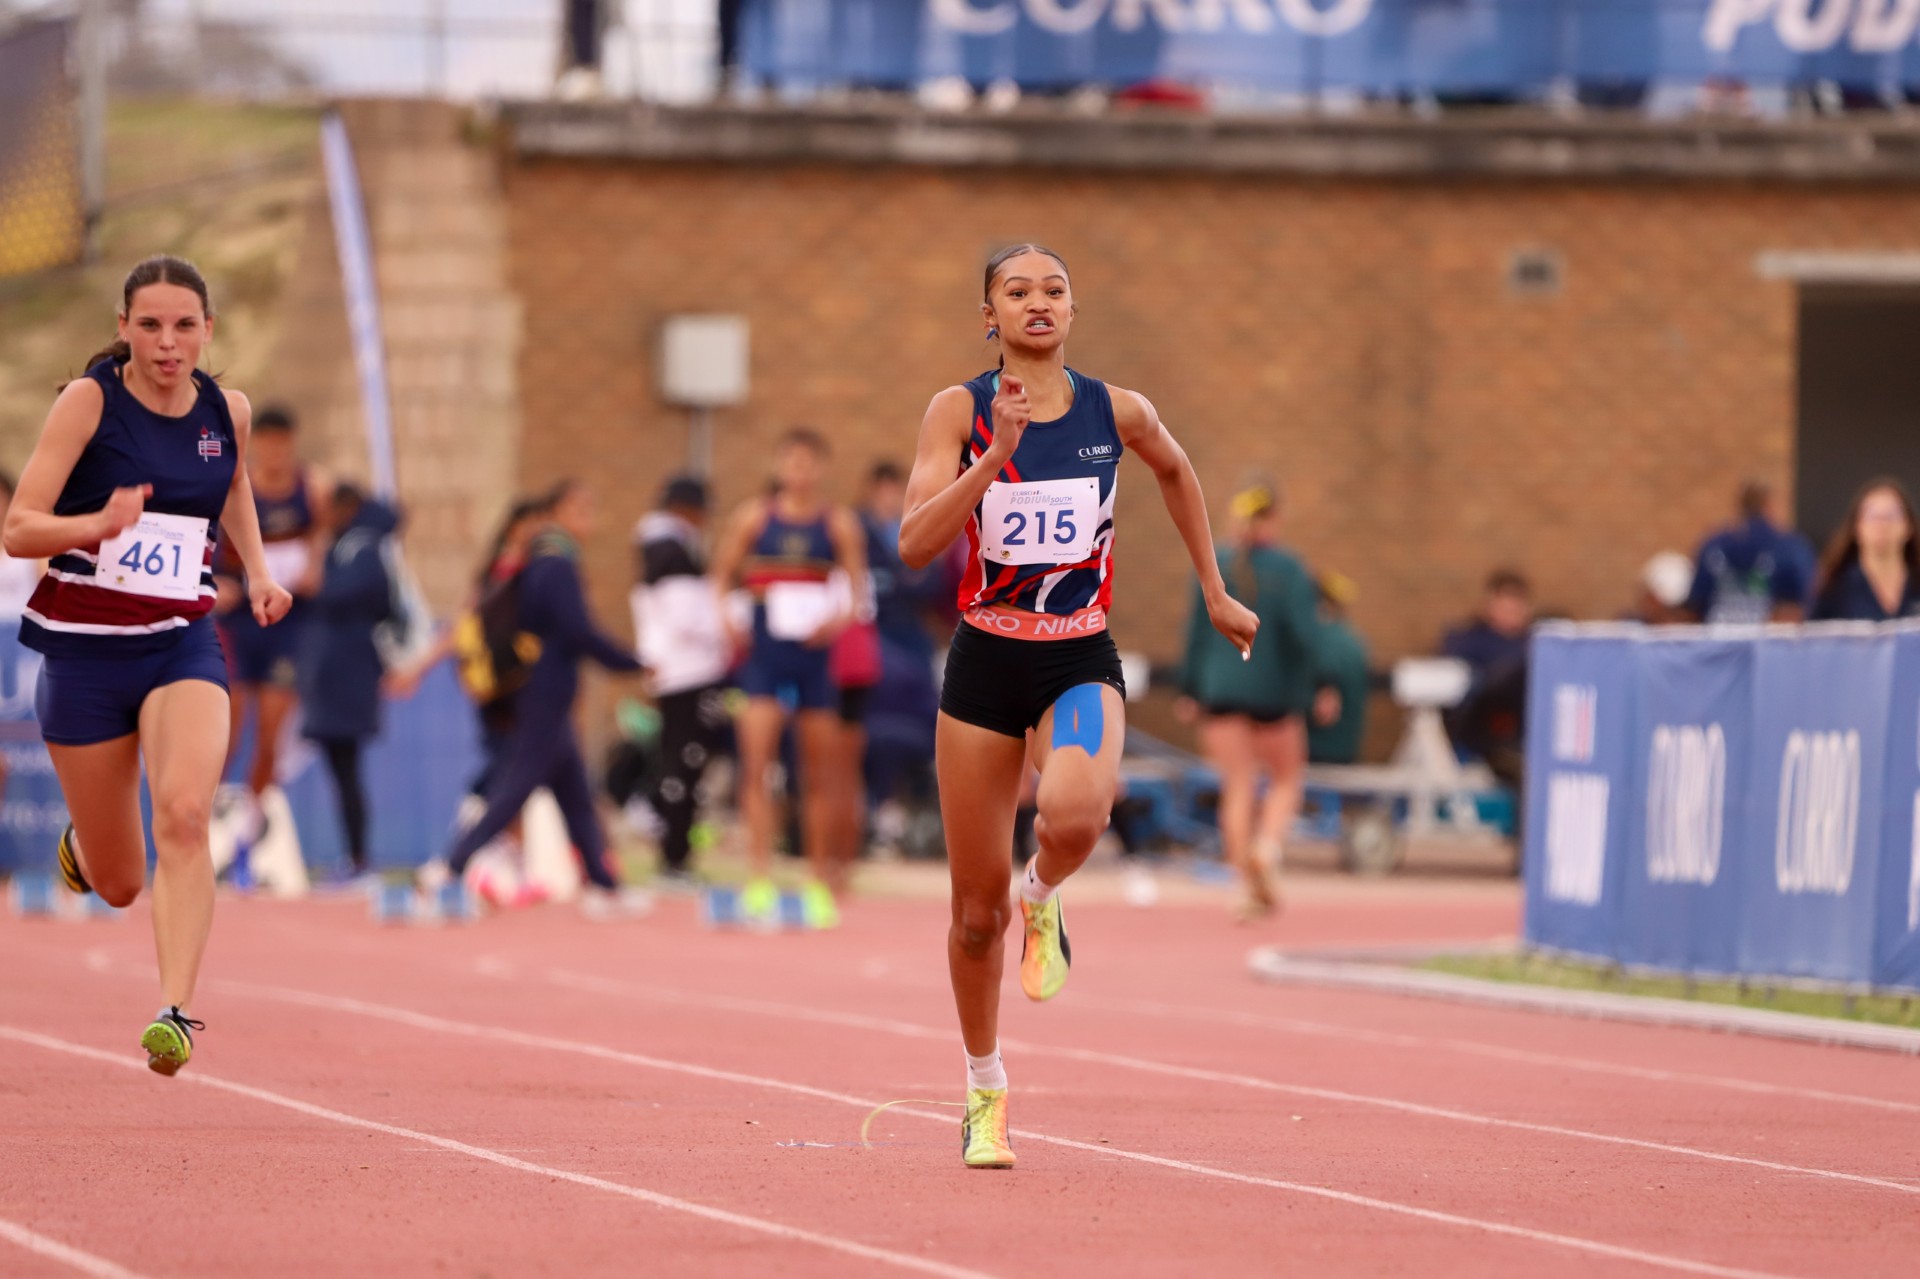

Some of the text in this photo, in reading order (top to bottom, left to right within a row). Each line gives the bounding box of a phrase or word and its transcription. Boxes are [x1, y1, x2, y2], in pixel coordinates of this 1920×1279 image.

[1078, 444, 1112, 458] CURRO
[1003, 509, 1077, 546] 215
[118, 541, 181, 578] 461
[1033, 610, 1102, 635] NIKE
